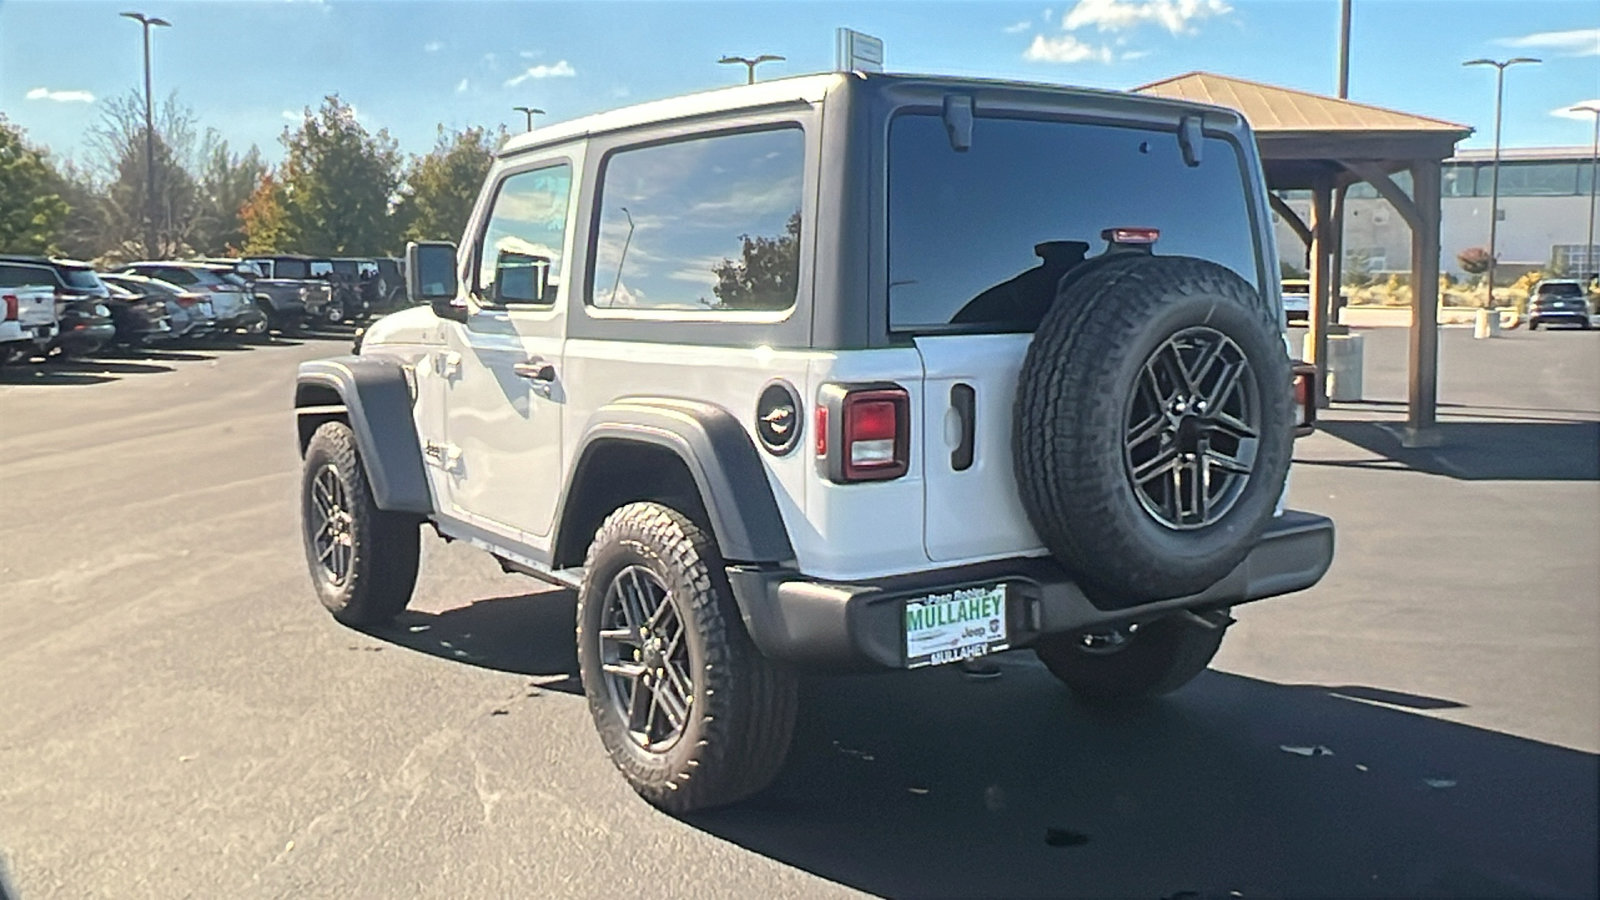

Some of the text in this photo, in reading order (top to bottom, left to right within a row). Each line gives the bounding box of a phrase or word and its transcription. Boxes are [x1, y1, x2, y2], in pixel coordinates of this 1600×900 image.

[907, 594, 1002, 632] MULLAHEY
[961, 627, 986, 639] Jeep
[931, 642, 988, 666] MULLAHEY
